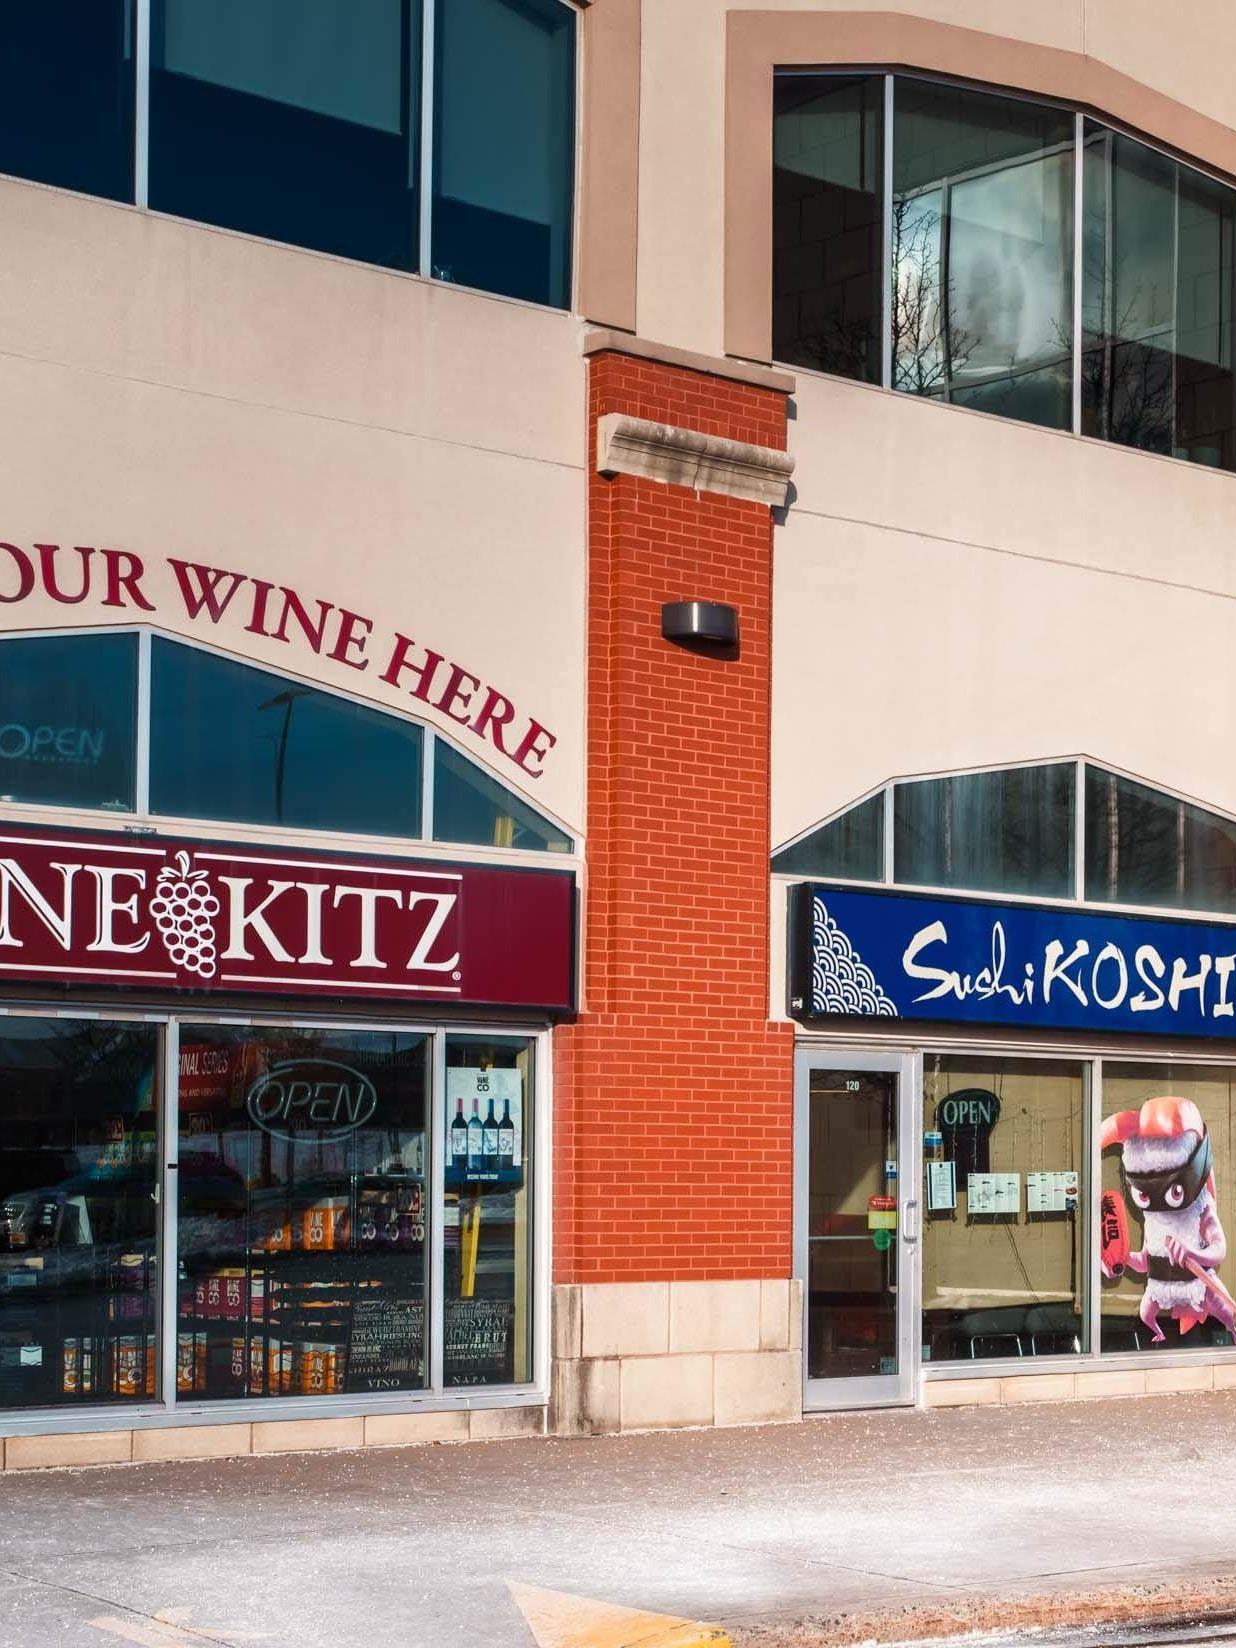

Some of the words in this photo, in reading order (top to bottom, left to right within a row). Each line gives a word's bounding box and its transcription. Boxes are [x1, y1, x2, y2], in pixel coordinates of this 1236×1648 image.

[166, 557, 375, 671] WINE
[379, 632, 558, 779] HERE
[0, 724, 104, 762] OPEN
[217, 875, 460, 972] KITZ
[902, 920, 1034, 1004] Sushi
[257, 1081, 366, 1122] OPEN
[846, 1081, 860, 1091] 120
[943, 1100, 992, 1125] OPEN
[368, 1379, 400, 1388] VINO
[453, 1376, 487, 1384] NAPA
